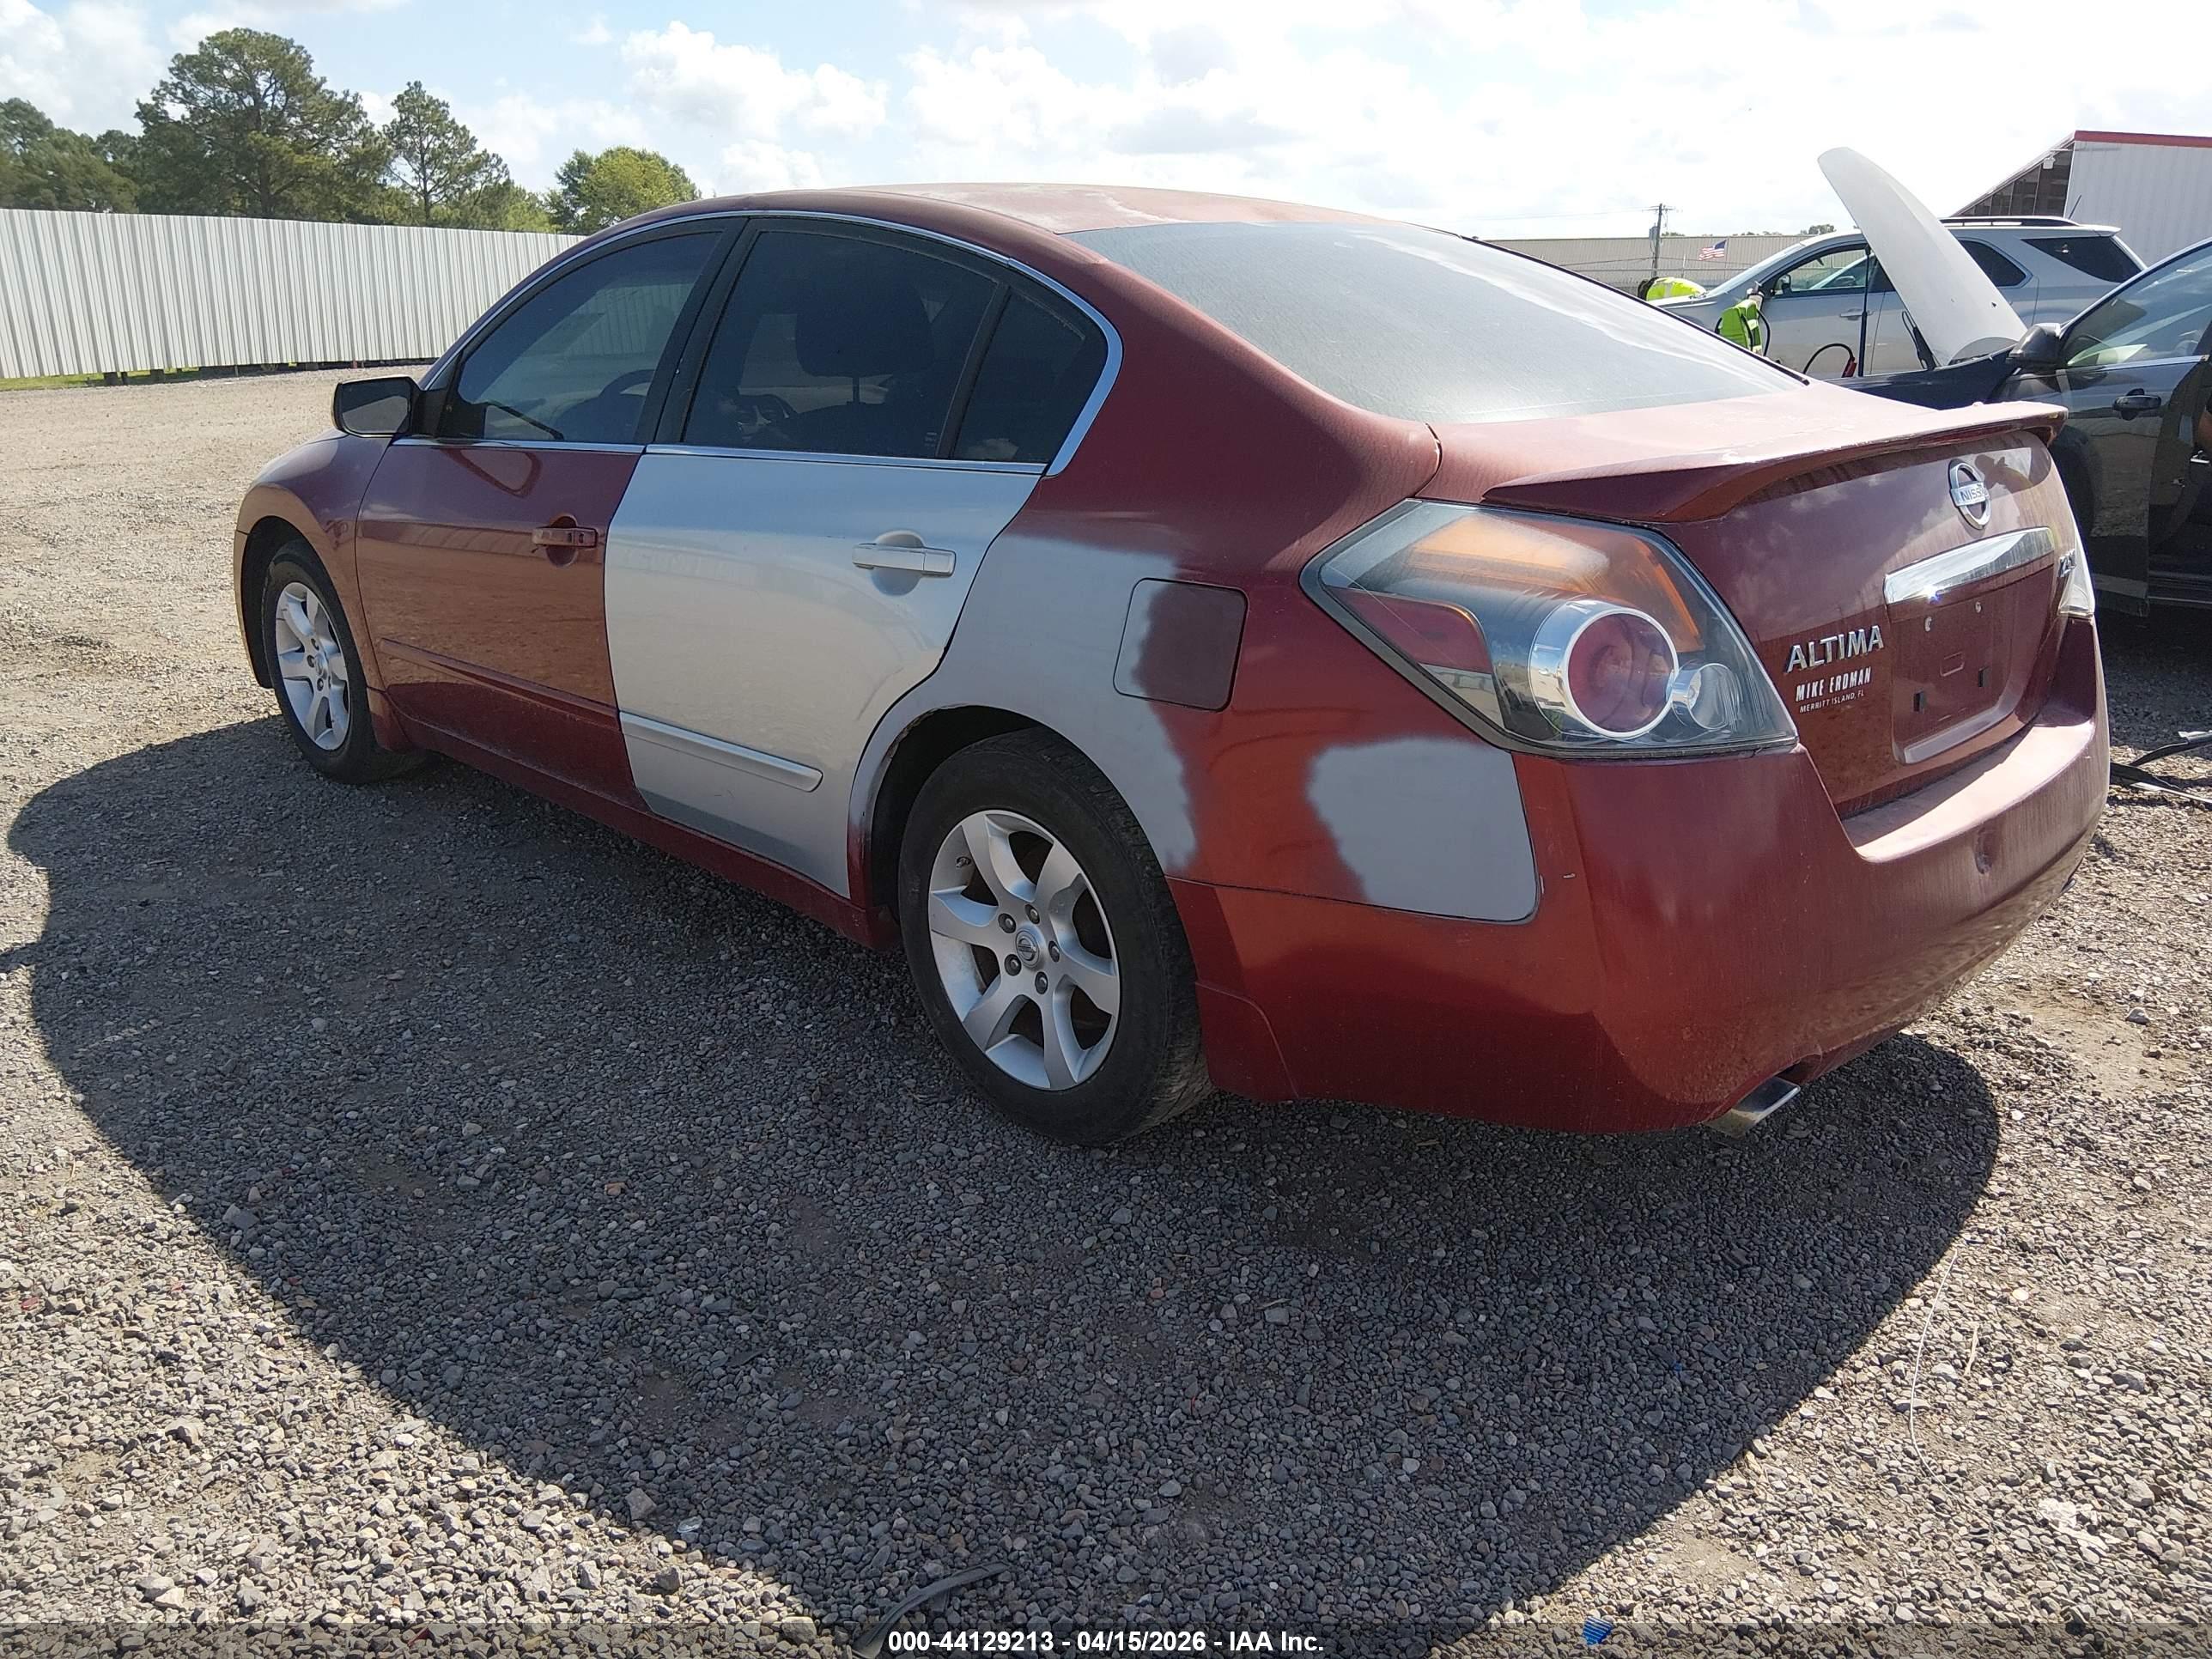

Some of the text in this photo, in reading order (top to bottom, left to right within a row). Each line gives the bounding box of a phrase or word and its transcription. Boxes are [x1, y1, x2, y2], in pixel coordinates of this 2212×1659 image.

[1786, 625, 1884, 673] ALTIMA
[1796, 666, 1871, 702] MIKE ERDMAN
[1800, 690, 1864, 714] MERRITT ISLAND, FL
